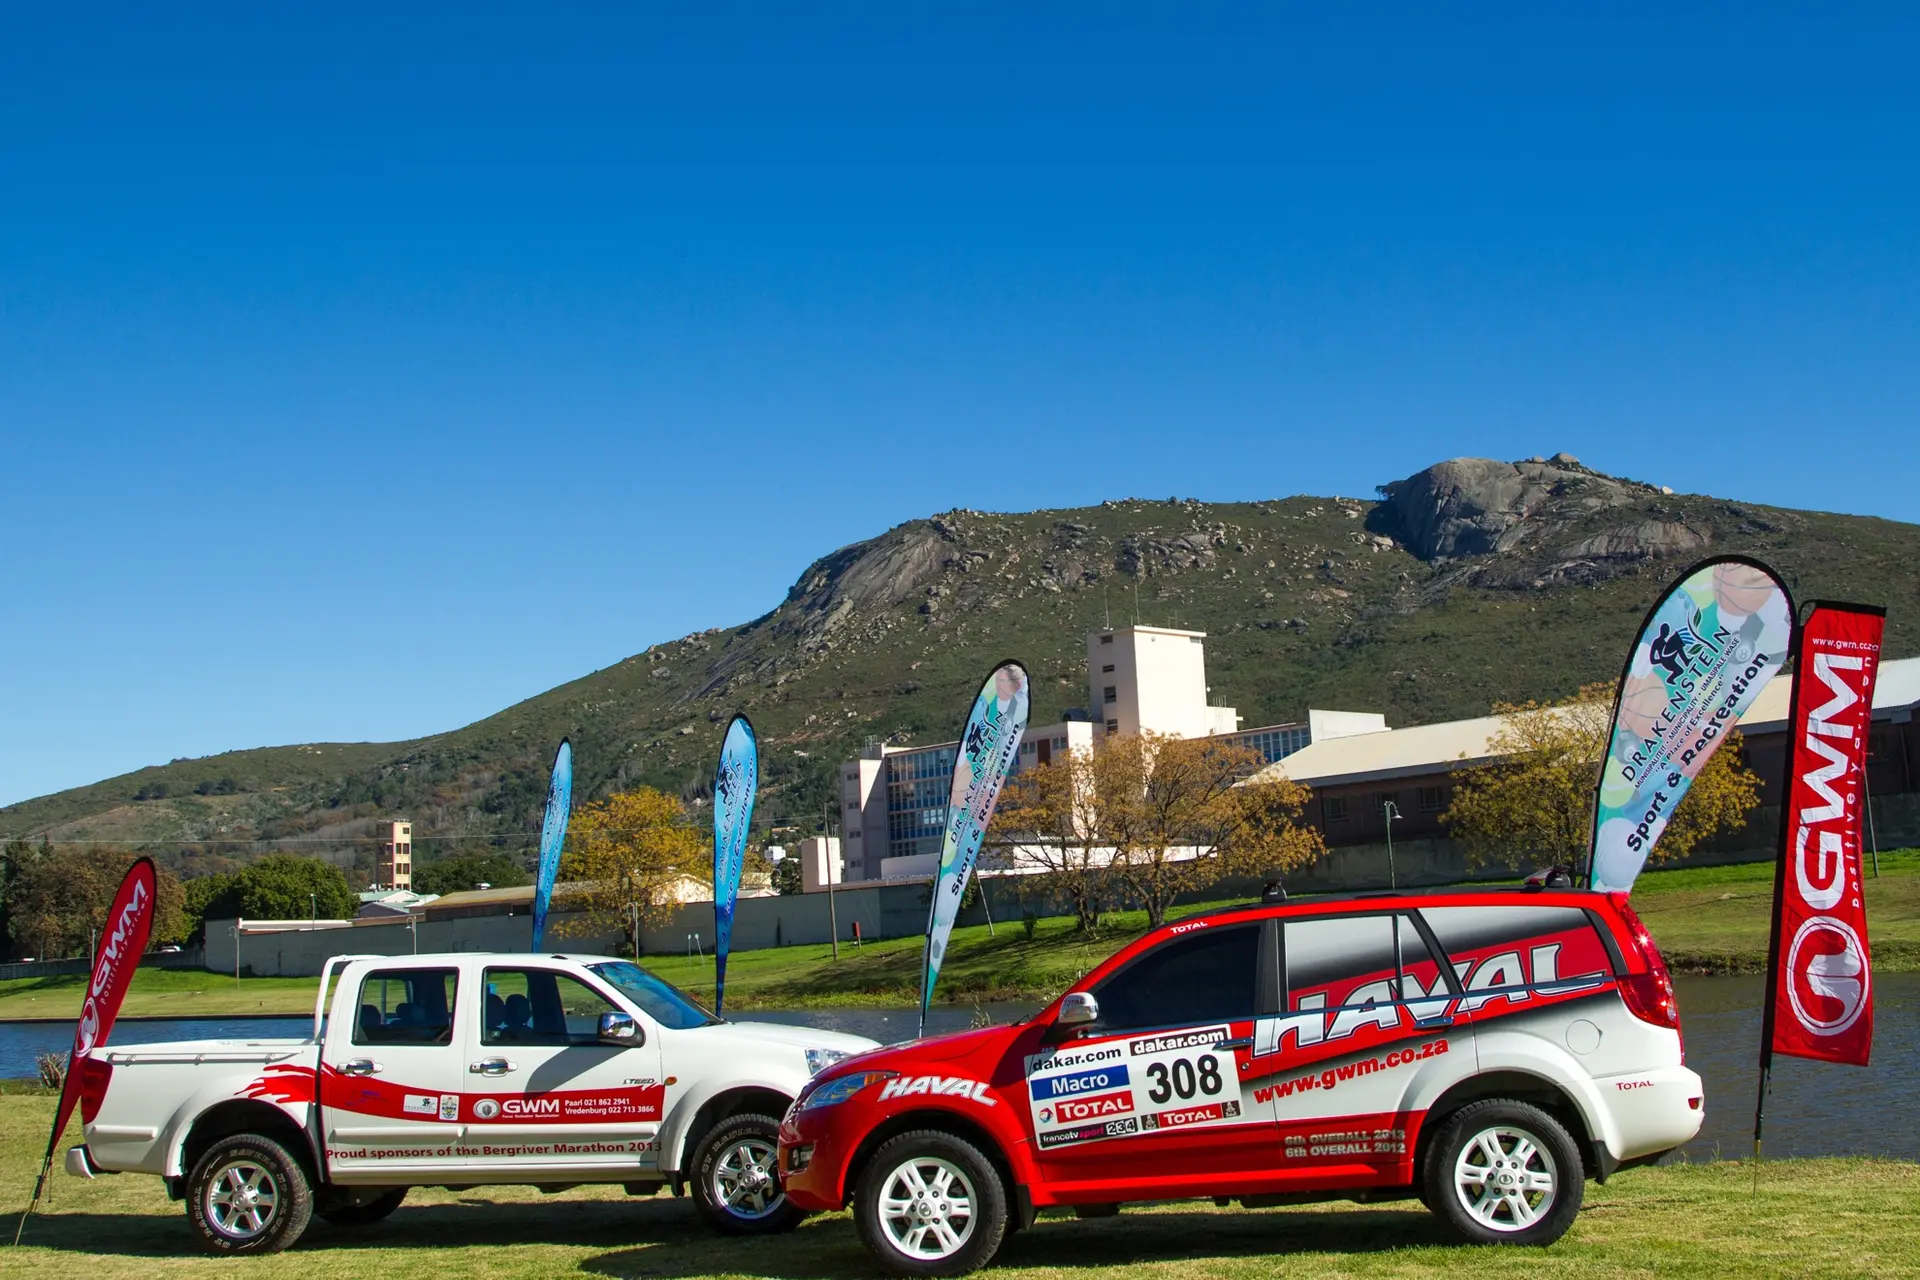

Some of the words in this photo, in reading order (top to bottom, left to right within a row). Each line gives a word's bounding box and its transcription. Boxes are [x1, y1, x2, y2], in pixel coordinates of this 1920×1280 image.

[1621, 622, 1732, 783] DRAKENSTEIN
[1634, 743, 1668, 789] MUNISIPALITEIT
[1668, 696, 1699, 741] MUNICIPALITY
[1700, 656, 1727, 692] UMASIPALE
[1724, 636, 1741, 660] WASE
[1627, 791, 1669, 852] Sport
[1667, 771, 1683, 788] &
[1680, 653, 1770, 767] Recreation
[1665, 736, 1686, 761] Place
[1684, 726, 1693, 737] of
[951, 710, 1003, 844] DRAKENSTEIN
[1796, 653, 1863, 911] GWM
[951, 846, 974, 896] Sport
[971, 829, 981, 842] &
[978, 723, 1020, 823] Recreation
[93, 879, 147, 997] GWM
[1170, 921, 1208, 934] TOTAL
[100, 940, 128, 1005] positively
[1253, 942, 1607, 1058] HAVAL
[1033, 1047, 1122, 1072] dakar.com
[1134, 1029, 1225, 1055] dakar.com
[1052, 1074, 1109, 1095] Macro
[1146, 1054, 1223, 1104] 308
[1254, 1037, 1449, 1104] www.gwm.co.za
[1615, 1080, 1655, 1091] TOTAL
[502, 1099, 560, 1114] GWM
[565, 1099, 583, 1107] Paarl
[877, 1075, 998, 1106] HAVAL
[565, 1107, 607, 1115] Vredenburg
[637, 1105, 655, 1113] 3866
[1059, 1098, 1131, 1119] TOTAL
[1163, 1110, 1216, 1125] TOTAL
[326, 1148, 366, 1160] Proud
[370, 1147, 433, 1160] sponsors
[436, 1146, 452, 1157] of
[456, 1145, 479, 1156] the
[483, 1145, 550, 1157] Bergriver
[554, 1142, 625, 1154] Marathon
[629, 1141, 662, 1152] 2013
[1285, 1147, 1307, 1158] 6th
[1309, 1143, 1372, 1156] OVERALL
[1373, 1142, 1406, 1154] 2012
[1309, 1130, 1371, 1144] OVERALL
